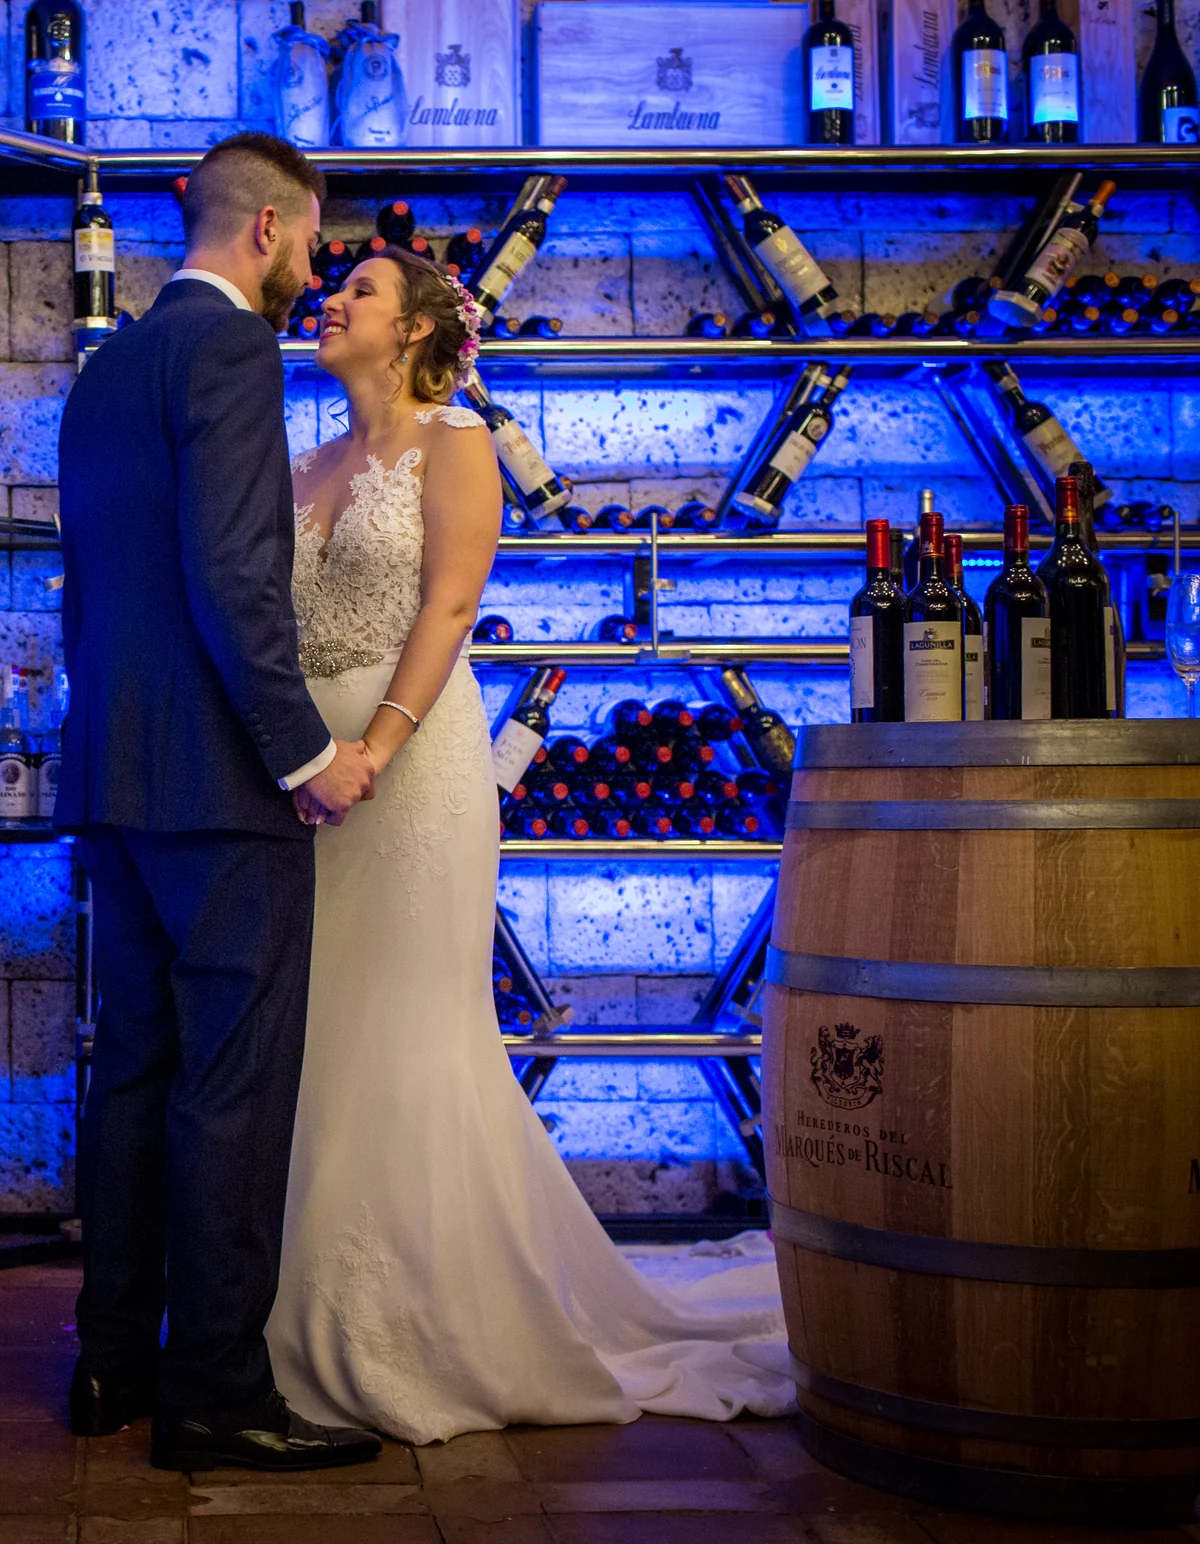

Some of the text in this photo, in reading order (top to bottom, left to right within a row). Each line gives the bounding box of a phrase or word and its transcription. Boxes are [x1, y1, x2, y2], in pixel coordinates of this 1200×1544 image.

[827, 1094, 862, 1107] VICTORIA
[797, 1110, 908, 1145] HEREDEROS DEL
[775, 1124, 953, 1189] MARQUÉS DE RISCAL
